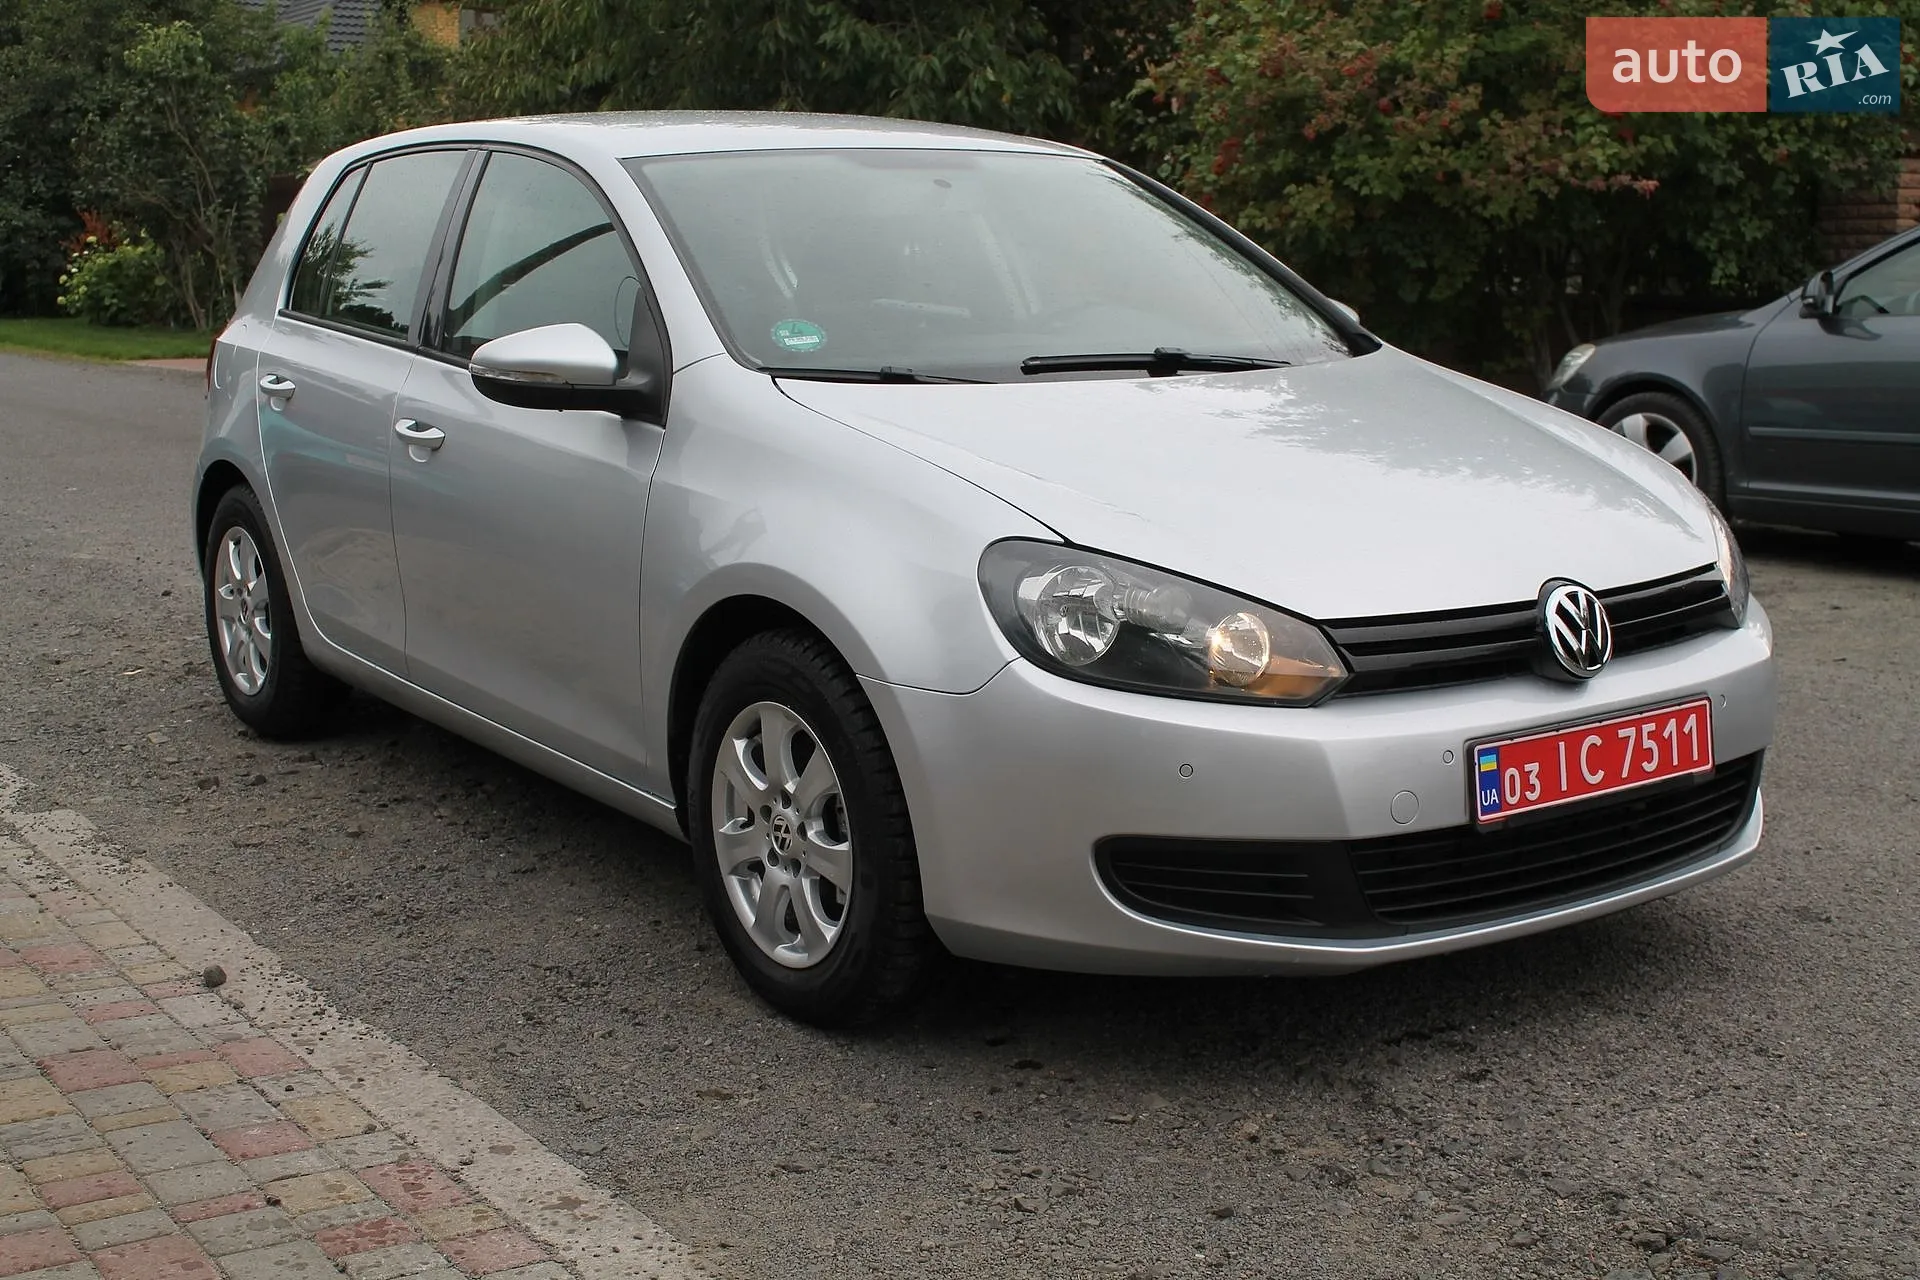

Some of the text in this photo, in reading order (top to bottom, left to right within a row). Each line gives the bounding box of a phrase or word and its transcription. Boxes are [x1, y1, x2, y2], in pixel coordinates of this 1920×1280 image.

[1504, 713, 1699, 805] 03 IC 7511
[1481, 789, 1499, 805] UA
